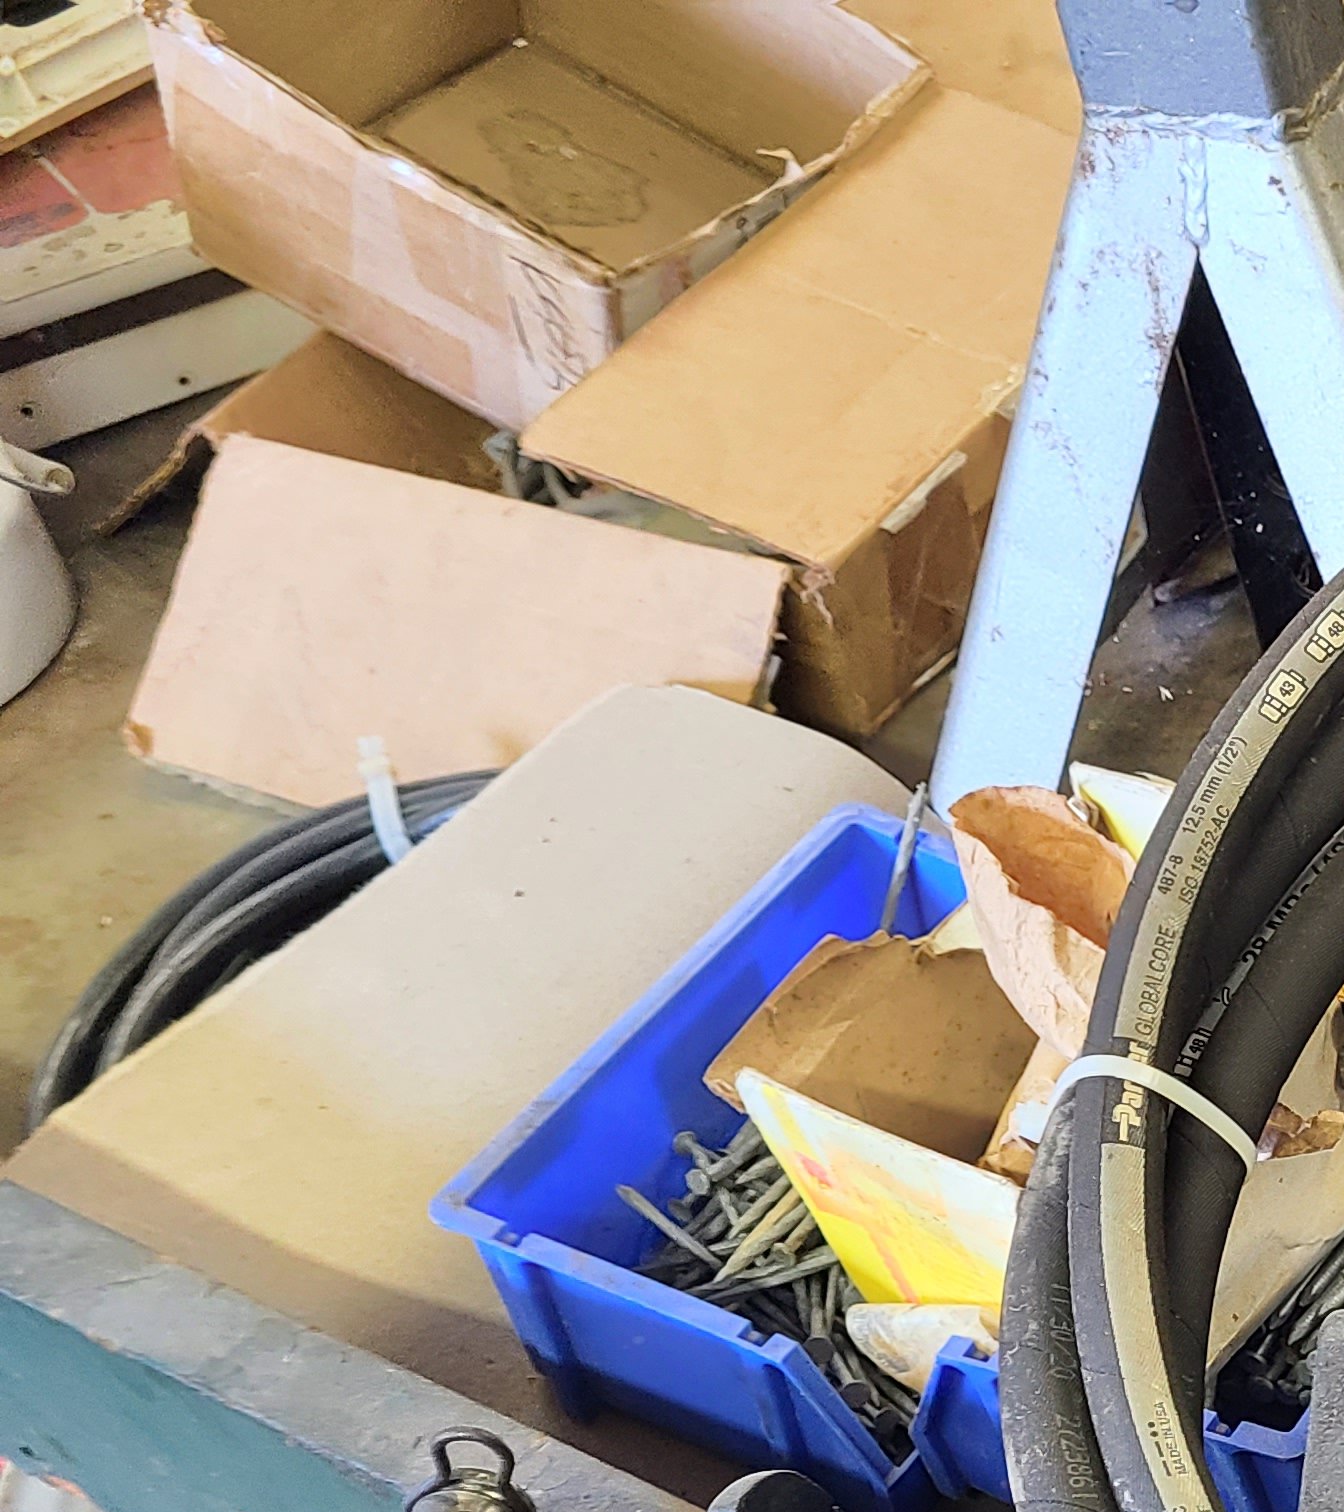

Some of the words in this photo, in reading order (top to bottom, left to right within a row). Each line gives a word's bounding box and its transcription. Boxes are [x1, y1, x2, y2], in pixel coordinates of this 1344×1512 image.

[1278, 681, 1297, 698] 43
[1157, 854, 1184, 896] 487-8
[1181, 803, 1206, 835] 12,5
[1199, 776, 1224, 808] mm
[1177, 875, 1201, 904] ISO
[1134, 922, 1178, 1037] GLOBALCORE
[1155, 1401, 1171, 1428] USA
[1169, 1440, 1188, 1476] MADE
